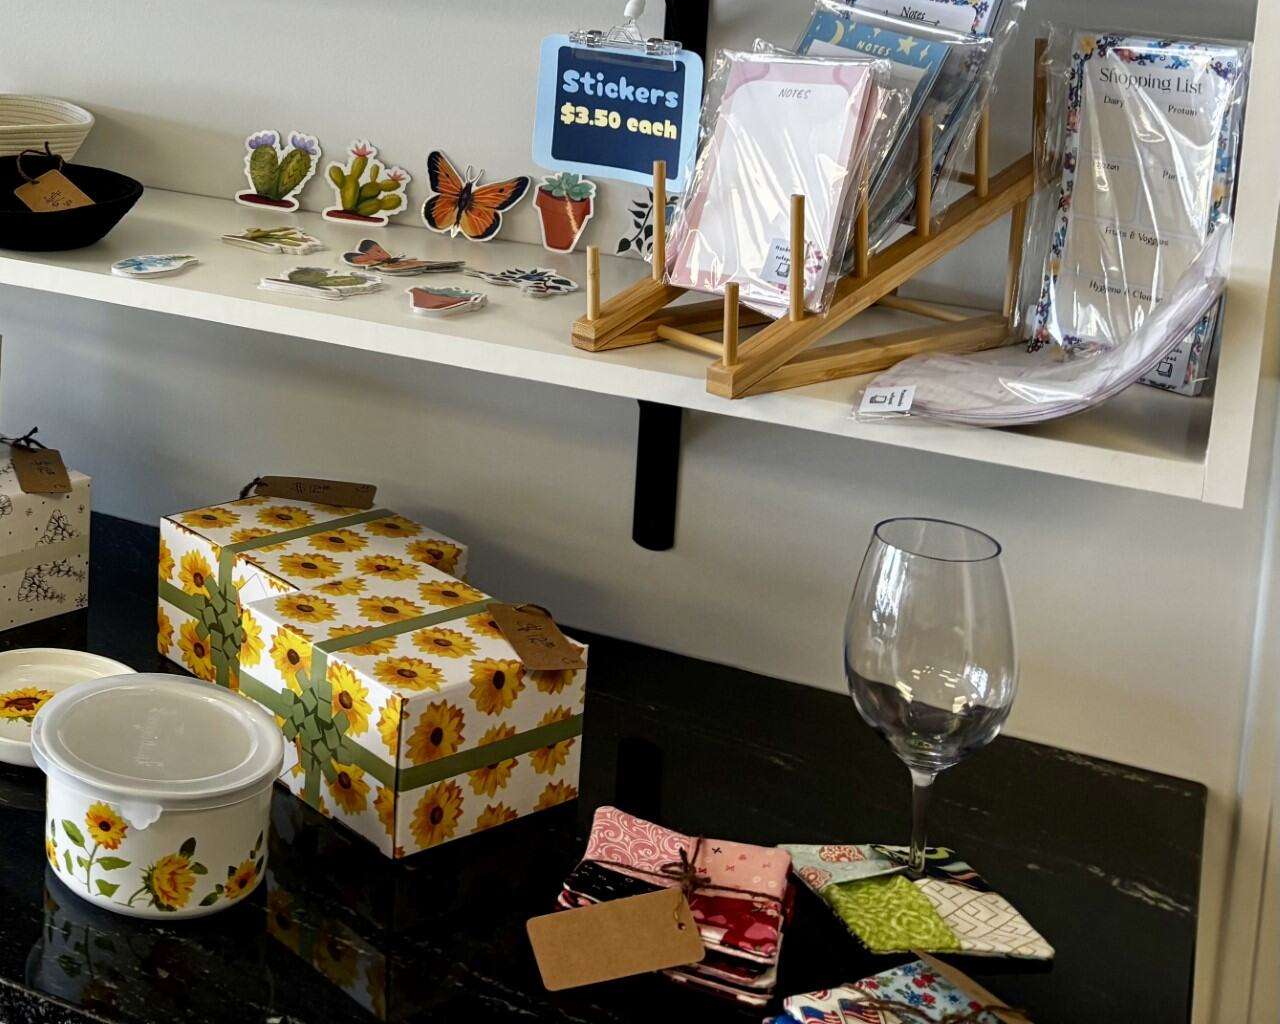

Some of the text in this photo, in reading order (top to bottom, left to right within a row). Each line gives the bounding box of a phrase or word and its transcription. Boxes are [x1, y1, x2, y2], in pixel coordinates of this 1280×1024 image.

[900, 6, 926, 20] Notes
[856, 40, 892, 56] NOTES
[562, 69, 680, 109] Stickers
[1099, 67, 1203, 95] Shopping List
[778, 87, 812, 100] NOTES
[560, 102, 677, 140] $3.50 each
